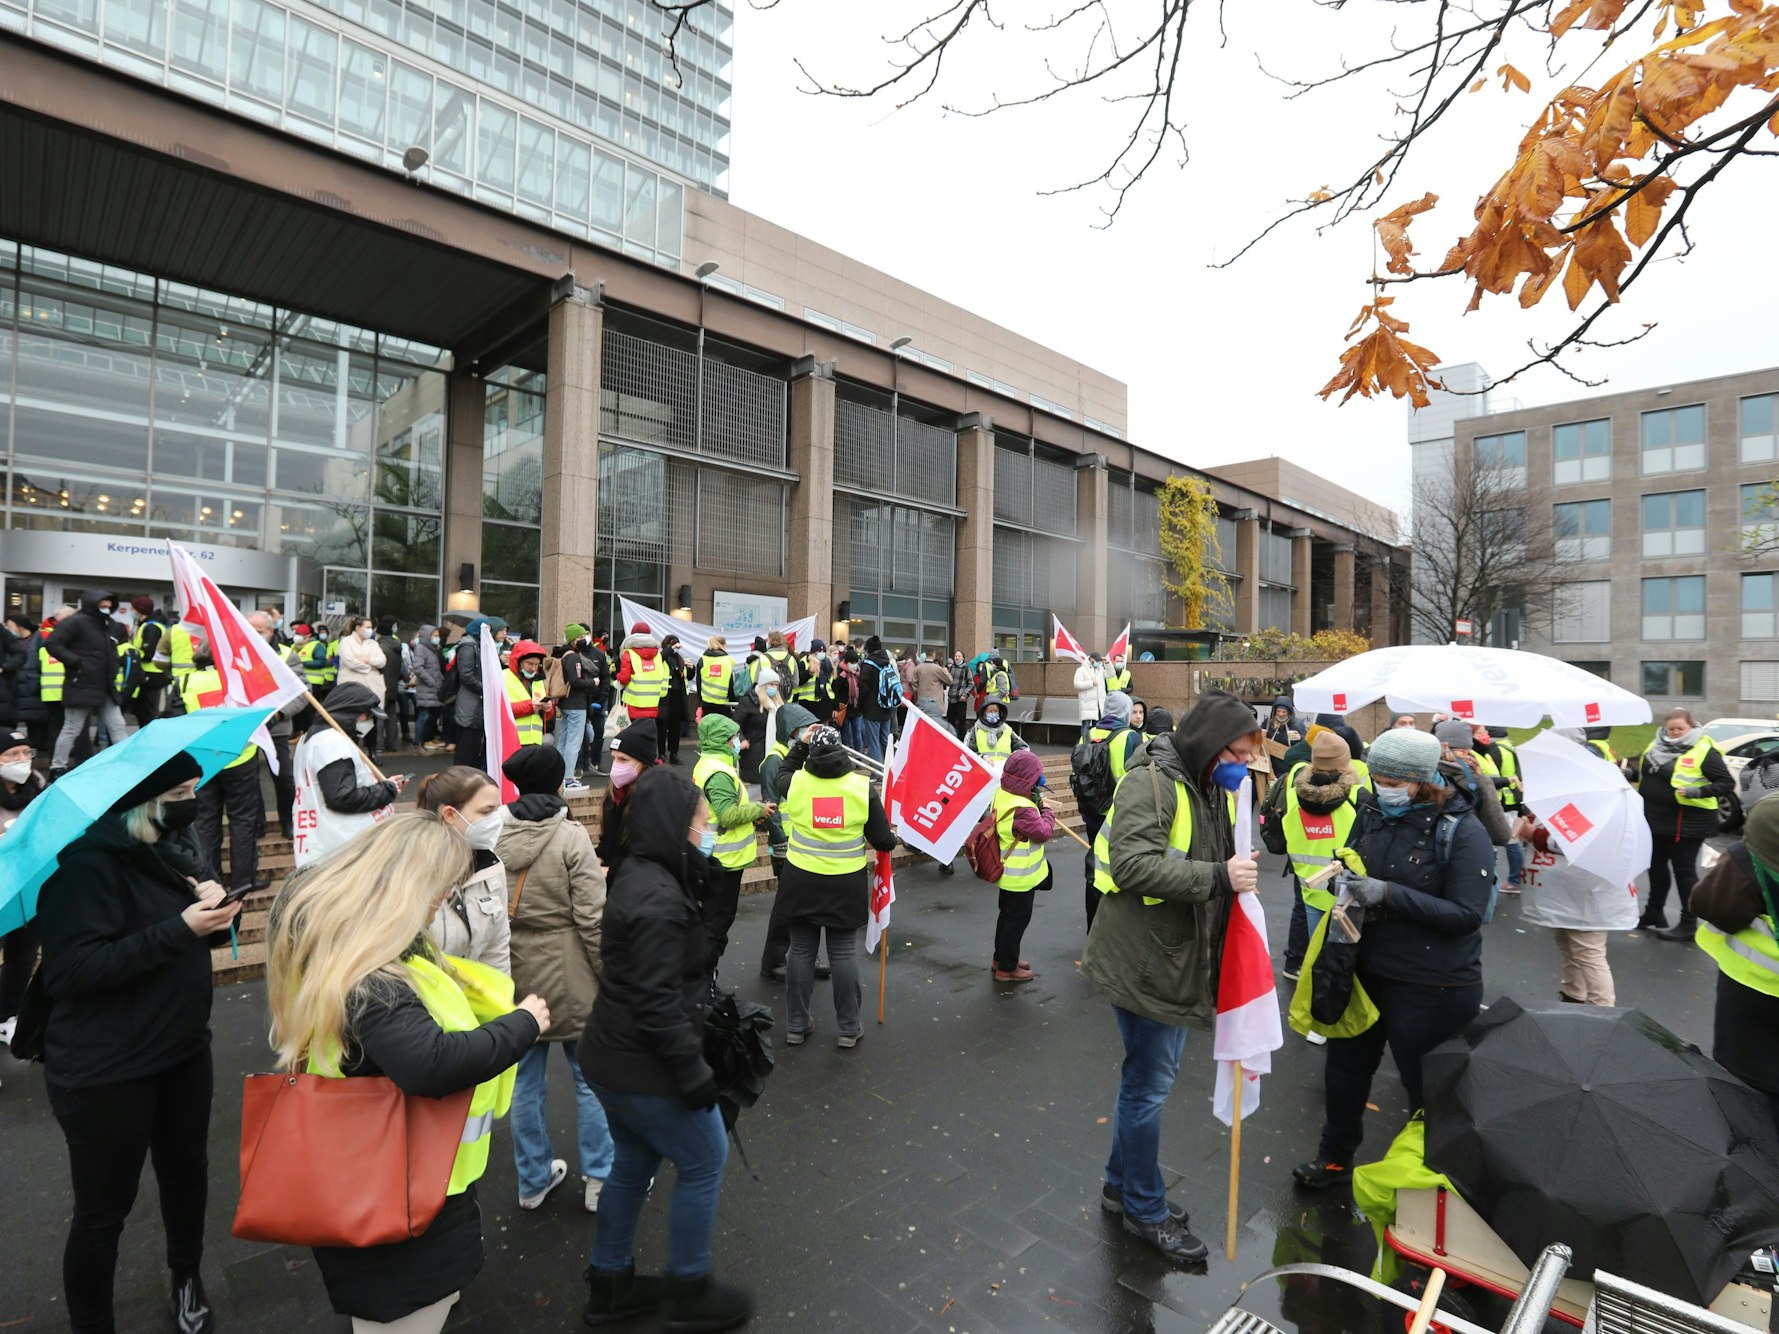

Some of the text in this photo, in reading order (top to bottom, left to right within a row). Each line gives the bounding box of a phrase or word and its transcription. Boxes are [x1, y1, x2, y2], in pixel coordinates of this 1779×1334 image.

[200, 551, 215, 560] 62
[814, 815, 842, 825] ver.di
[1305, 825, 1333, 834] ver.di
[1554, 813, 1579, 840] ver.di
